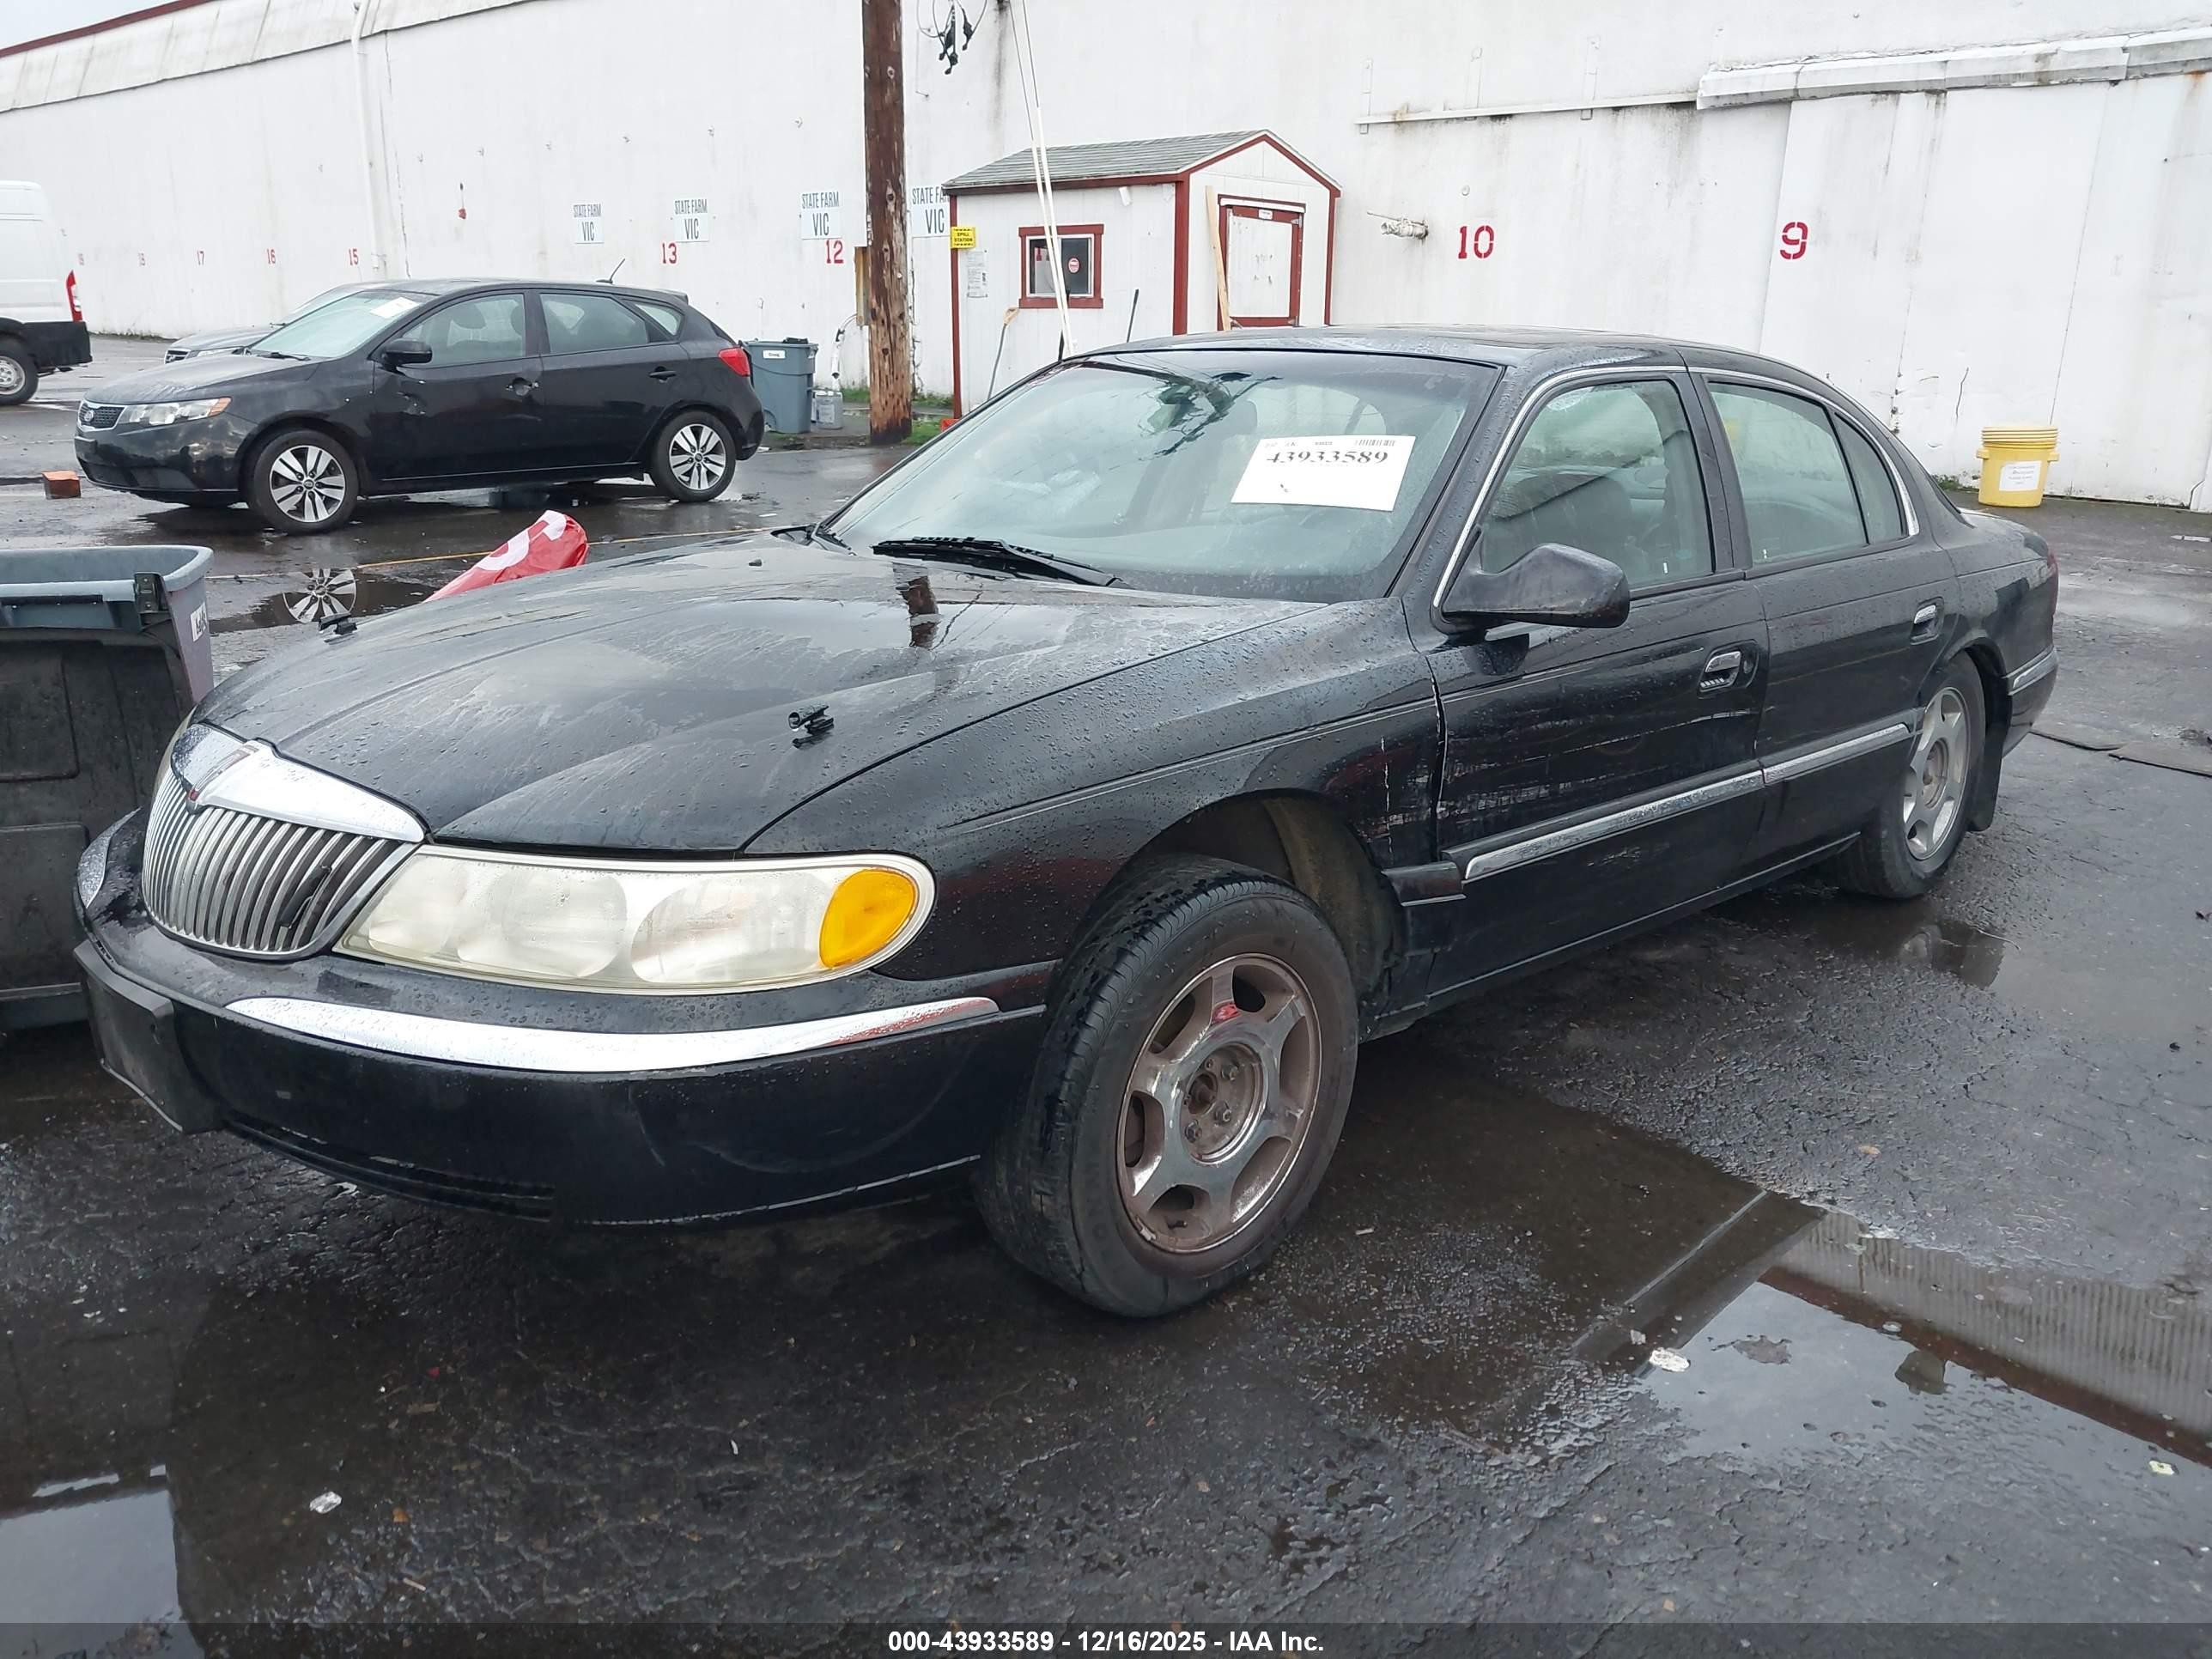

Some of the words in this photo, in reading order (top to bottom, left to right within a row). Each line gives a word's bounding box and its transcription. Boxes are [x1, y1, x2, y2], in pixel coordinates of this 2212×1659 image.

[801, 192, 819, 209] STATE
[820, 191, 840, 207] FARM
[912, 186, 933, 205] STATE
[573, 204, 586, 217] STATE
[587, 203, 601, 216] FARM
[675, 199, 690, 215] STATE
[691, 198, 708, 214] FARM
[581, 221, 595, 241] VIC
[684, 218, 700, 240] VIC
[812, 212, 830, 236] VIC
[925, 209, 945, 234] VIC
[1458, 225, 1494, 259] 10
[1780, 222, 1808, 260] 9
[197, 250, 204, 265] 17
[266, 248, 276, 264] 16
[349, 248, 359, 265] 15
[661, 242, 678, 264] 13
[825, 240, 844, 264] 12
[1267, 450, 1389, 464] 43933589
